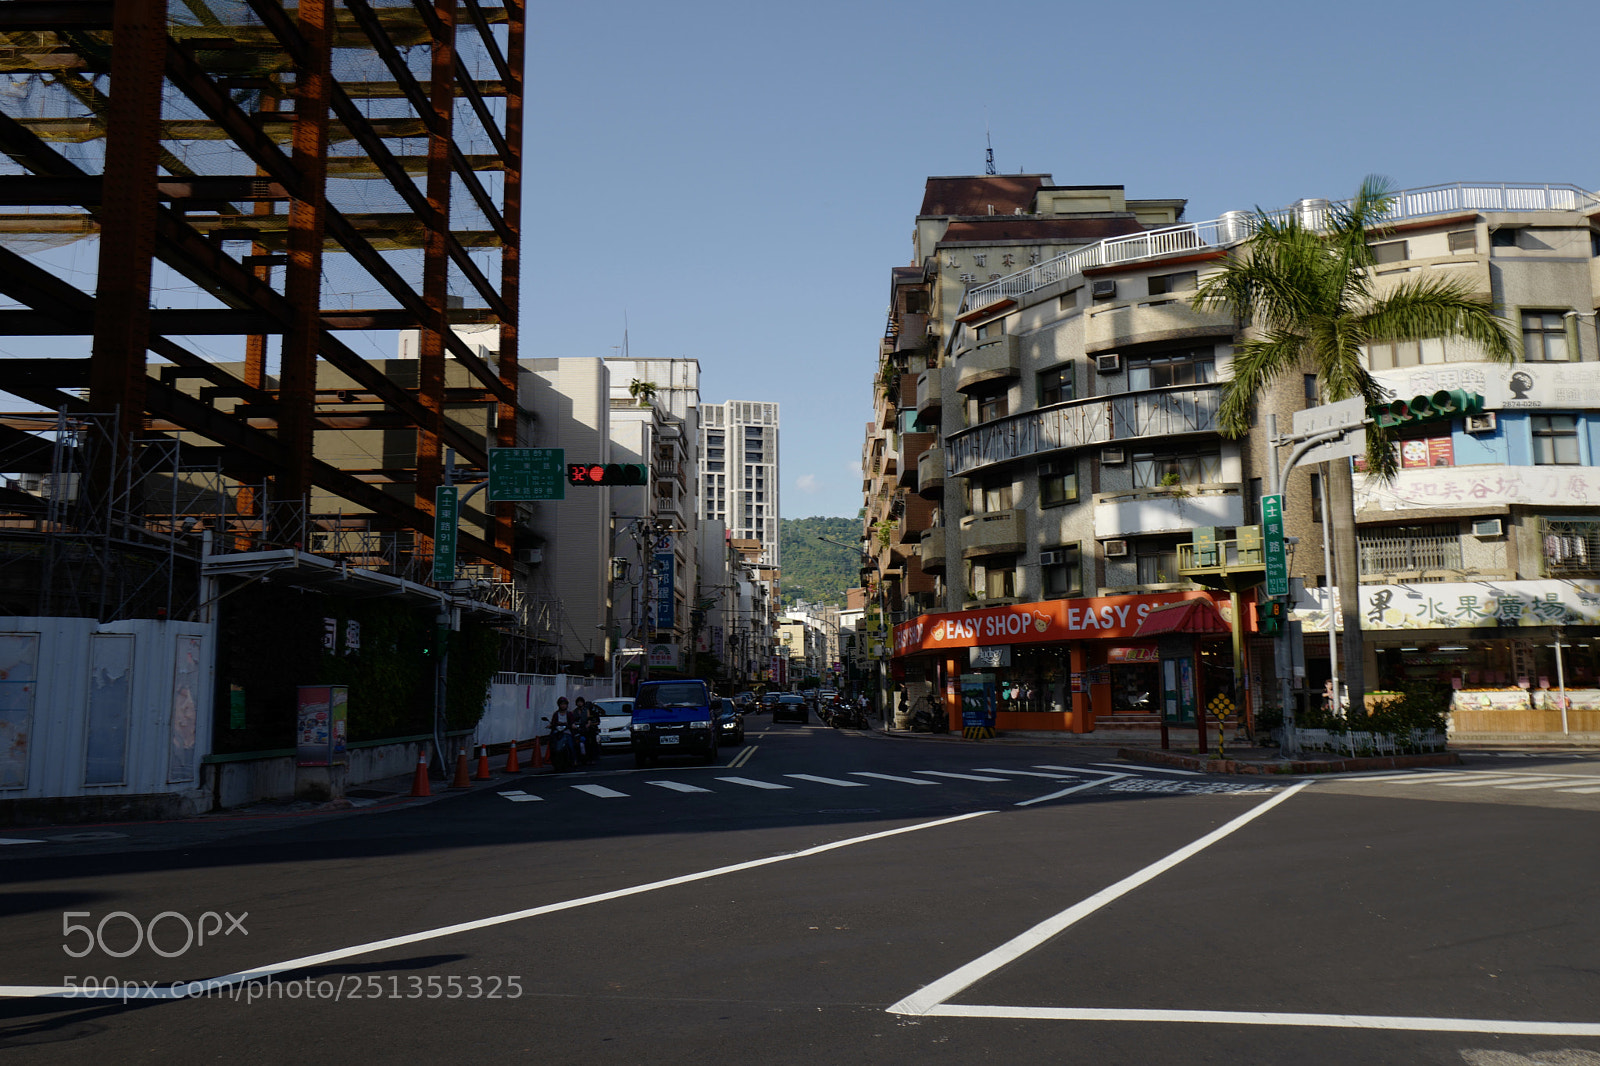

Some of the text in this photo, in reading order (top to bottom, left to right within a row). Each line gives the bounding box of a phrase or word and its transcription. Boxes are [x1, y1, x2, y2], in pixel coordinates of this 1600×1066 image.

[571, 466, 586, 481] 32
[1266, 507, 1280, 553] 士東路
[1068, 605, 1131, 631] EASY
[1416, 593, 1567, 619] 水果廣場
[946, 613, 1032, 639] EASY SHOP
